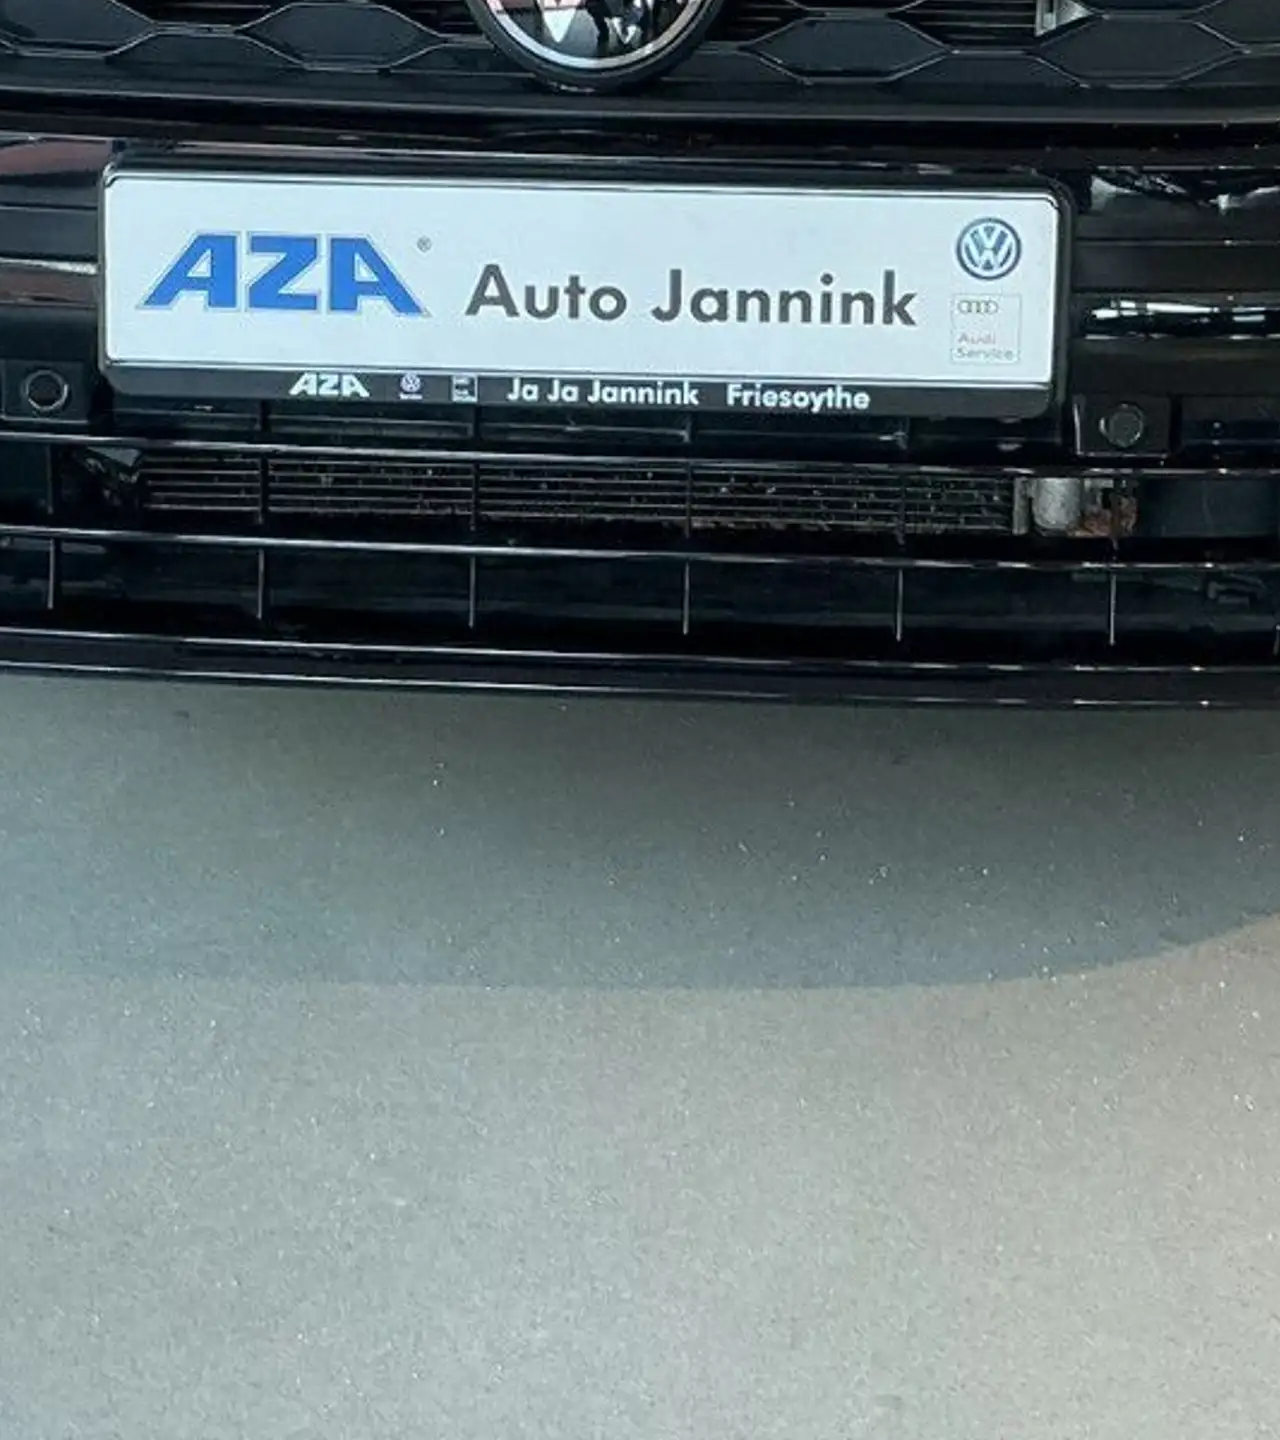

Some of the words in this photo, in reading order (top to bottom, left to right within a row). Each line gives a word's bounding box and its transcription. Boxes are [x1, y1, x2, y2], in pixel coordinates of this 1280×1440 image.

[466, 263, 627, 320] Auto
[651, 269, 917, 327] Jannink
[289, 372, 370, 398] AZA
[507, 378, 538, 402] Ja
[547, 378, 579, 403] Ja
[587, 380, 699, 406] Jannink
[727, 383, 870, 411] Friesoythe
